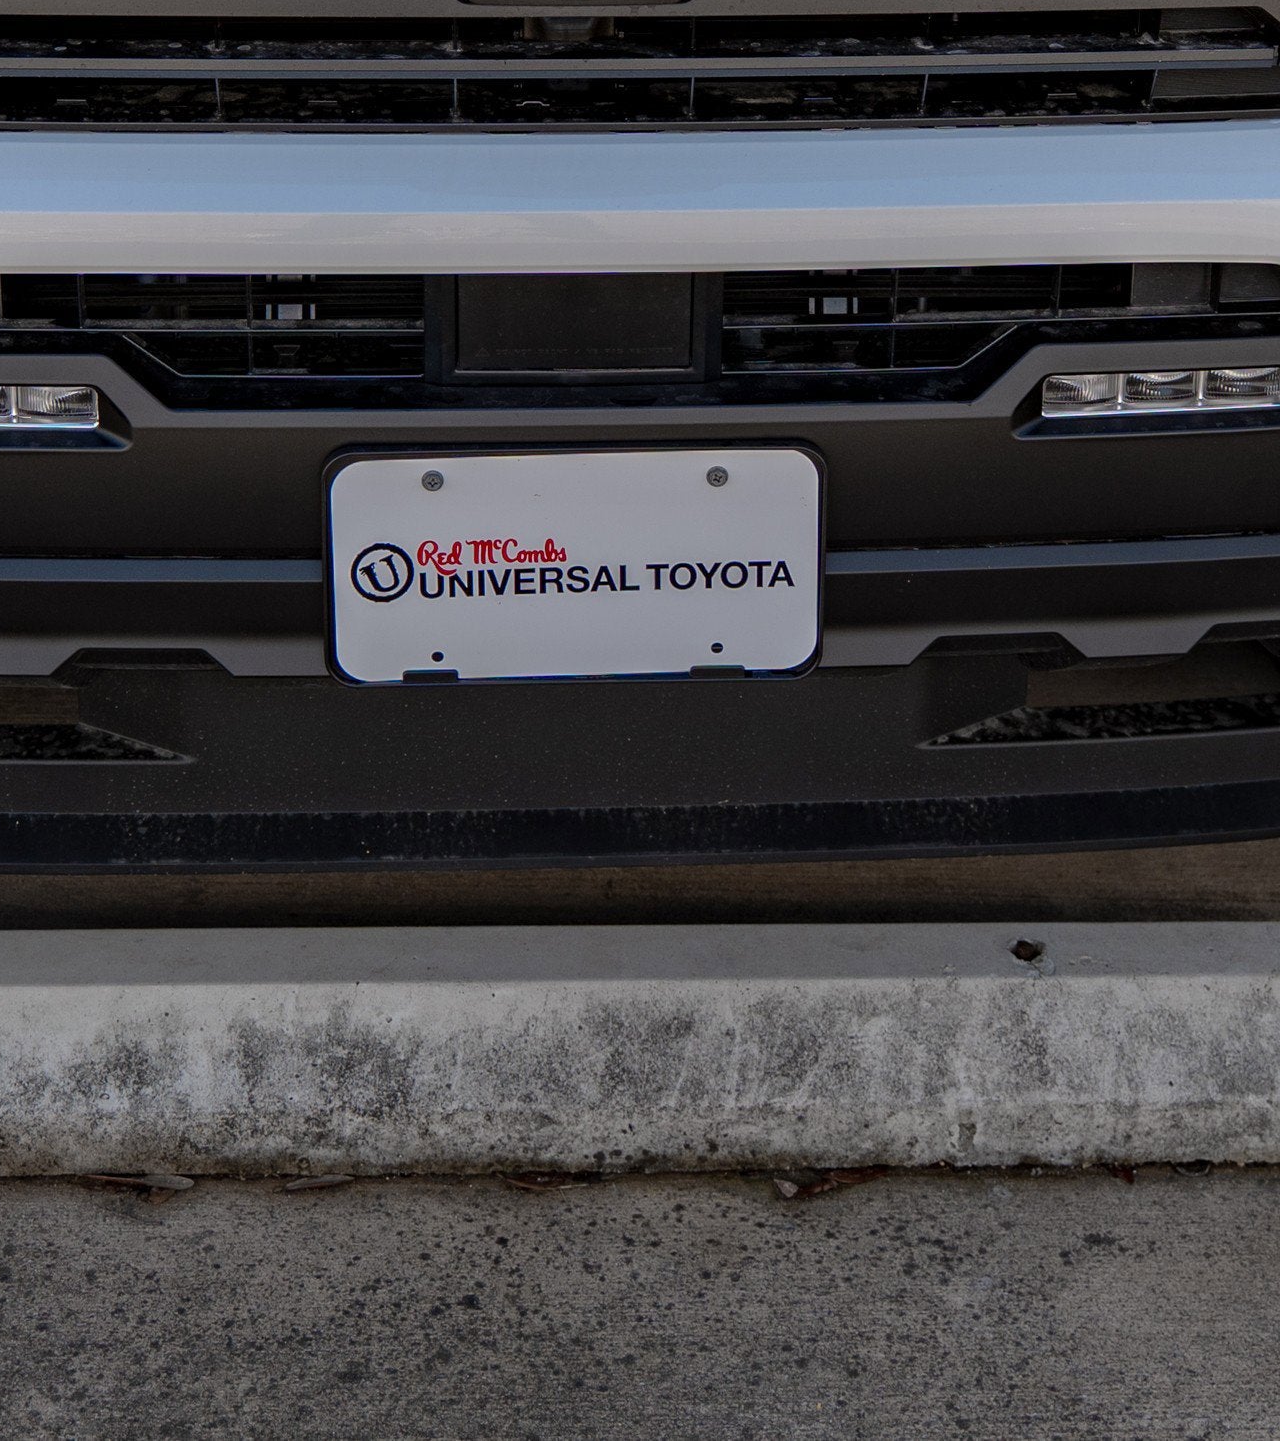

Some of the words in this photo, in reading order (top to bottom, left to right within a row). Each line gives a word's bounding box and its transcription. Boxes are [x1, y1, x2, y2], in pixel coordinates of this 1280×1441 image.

[417, 540, 462, 576] Red
[465, 538, 568, 565] McCombs
[419, 565, 640, 599] UNIVERSAL
[645, 560, 795, 591] TOYOTA
